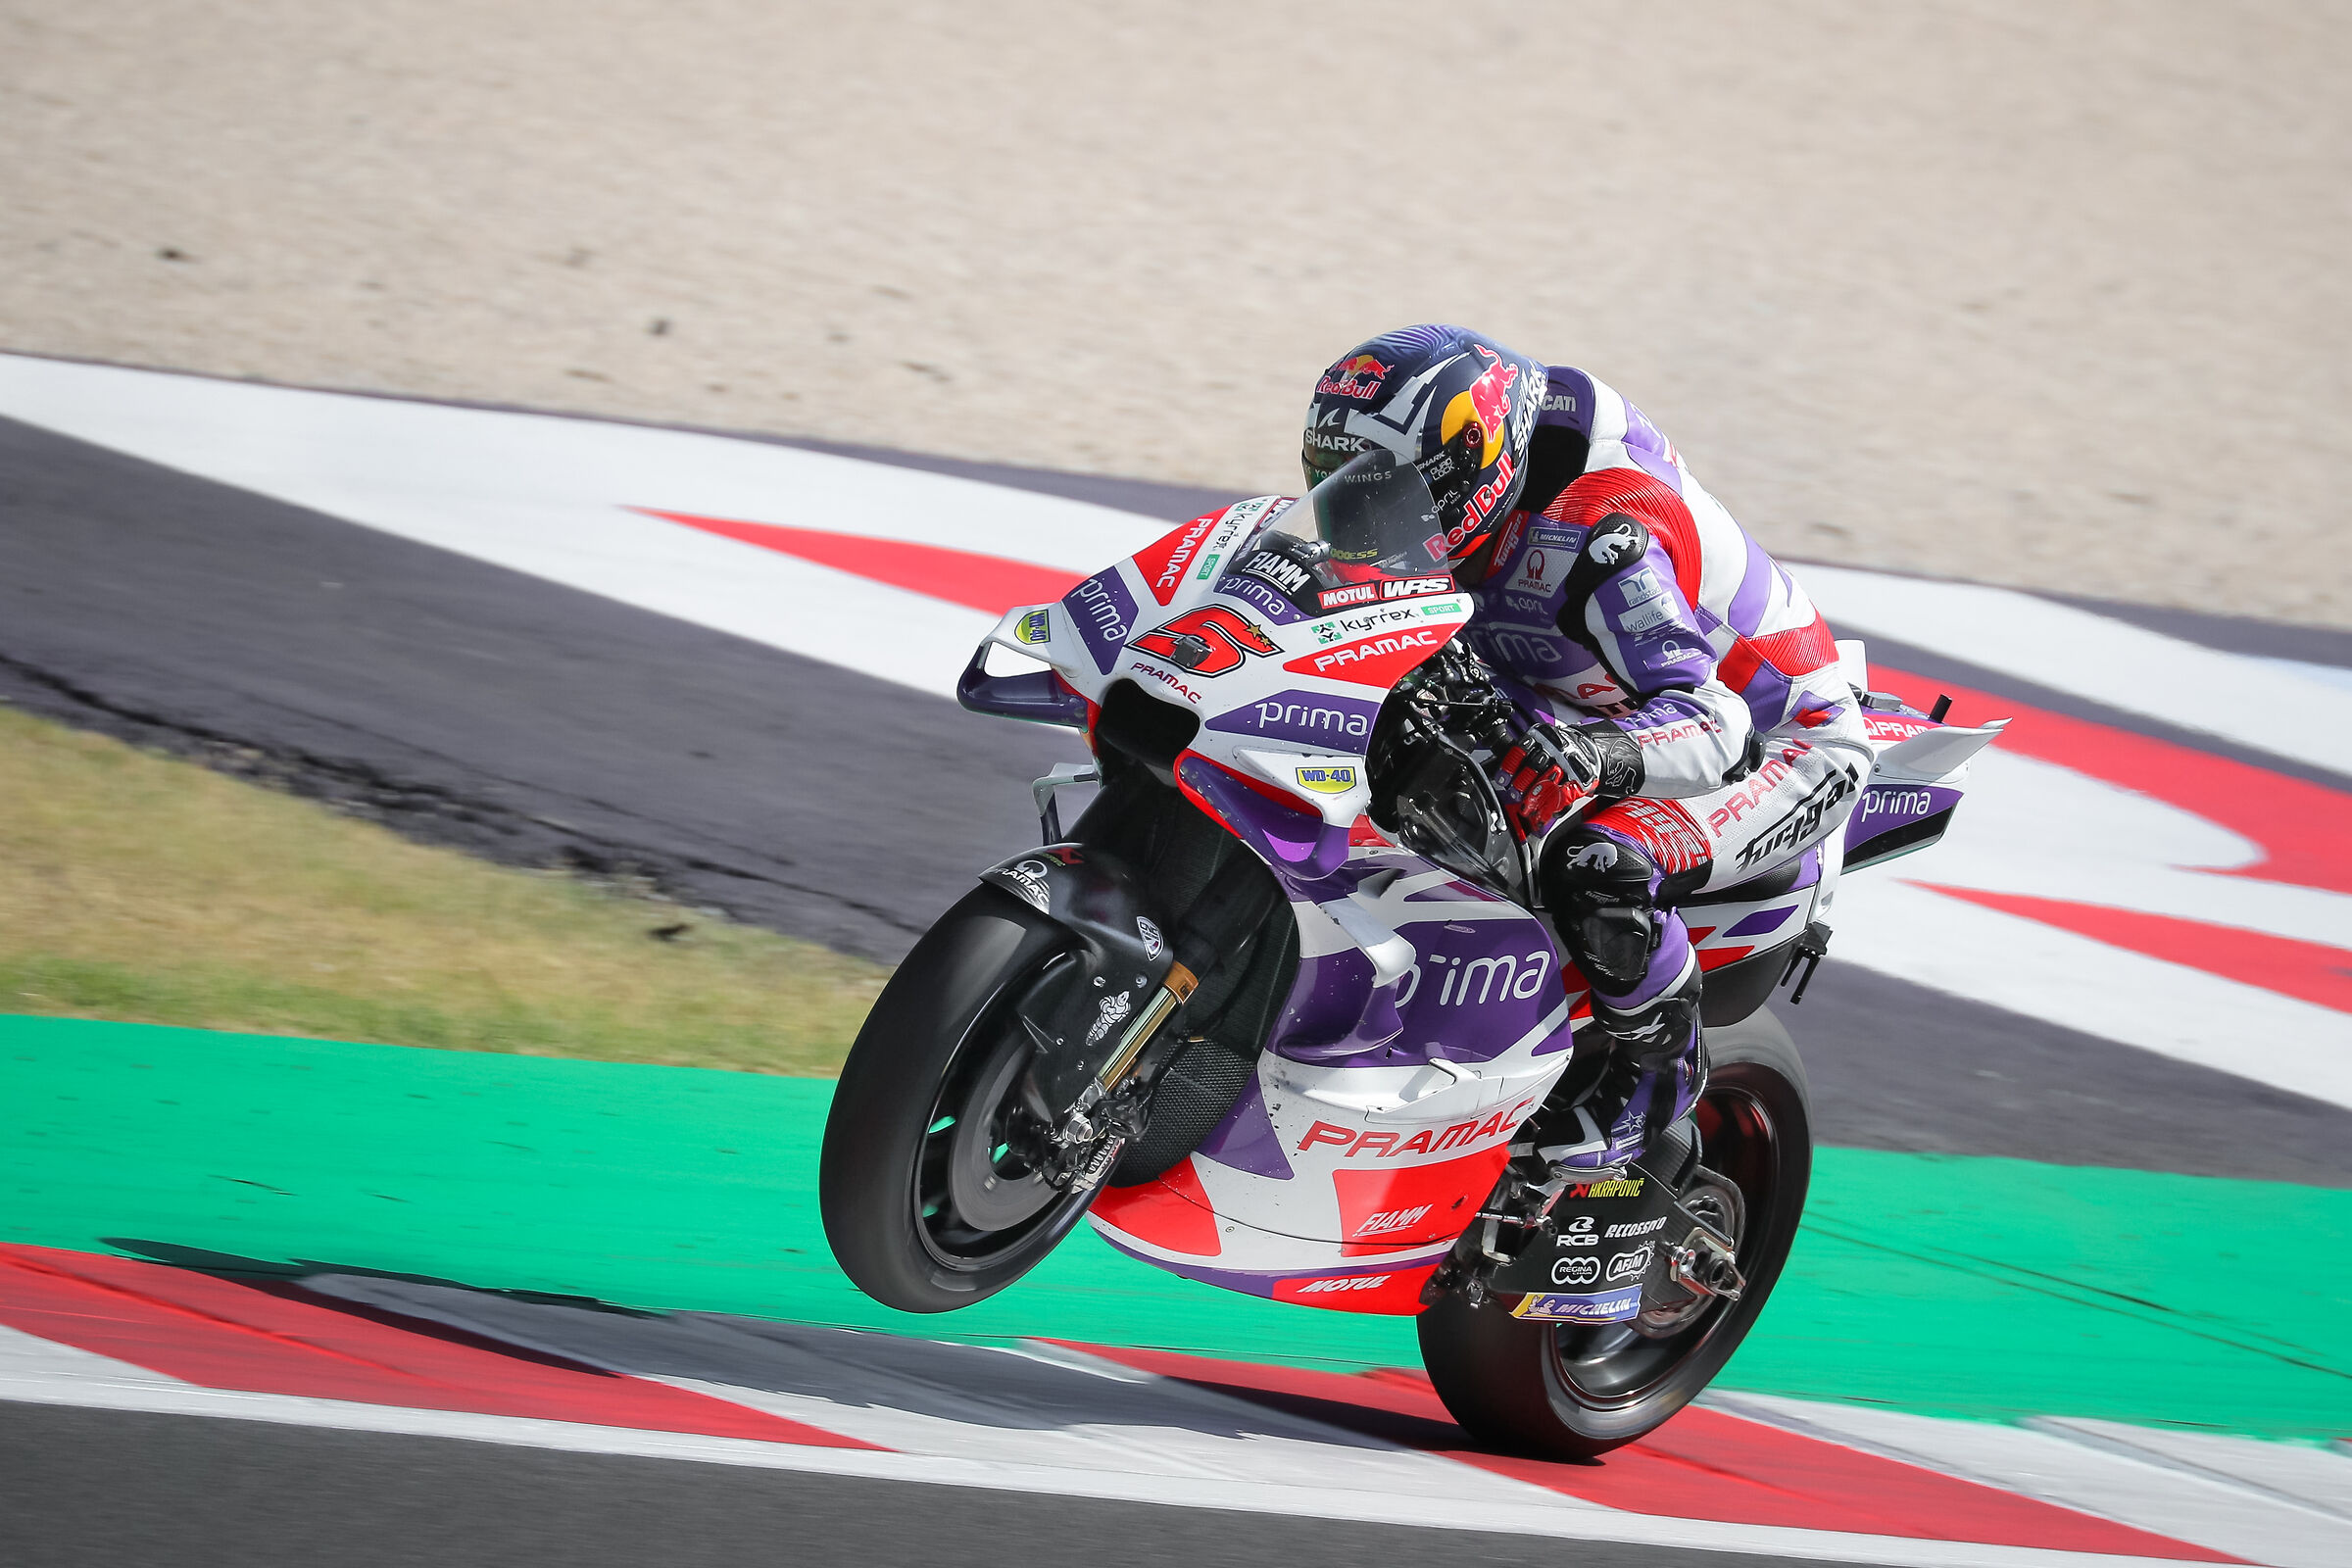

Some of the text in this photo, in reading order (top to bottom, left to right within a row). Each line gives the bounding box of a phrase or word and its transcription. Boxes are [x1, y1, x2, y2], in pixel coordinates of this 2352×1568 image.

[1541, 395, 1577, 412] CATI
[1304, 429, 1366, 452] SHARK
[1416, 451, 1446, 470] SHARK
[1344, 471, 1392, 483] WINGS
[1423, 500, 1483, 563] Red
[1473, 450, 1517, 517] Bull
[1540, 533, 1577, 544] MICHELIN
[1155, 517, 1213, 588] PRAMAC
[1246, 551, 1311, 595] FIAMM
[1222, 577, 1287, 616] prima
[1323, 586, 1375, 607] MOTUL
[1384, 577, 1449, 598] WRS
[1518, 579, 1551, 593] PRAMAC
[1629, 586, 1662, 607] randstad
[1070, 577, 1128, 642] prima
[1339, 609, 1413, 632] kyrrex
[1427, 604, 1455, 615] SPORT
[1627, 611, 1664, 633] wallife
[1124, 603, 1285, 678] 5
[1313, 631, 1438, 672] PRAMAC
[1130, 662, 1202, 705] PRAMAC
[1255, 702, 1368, 736] prima
[1301, 767, 1352, 783] WD-40
[1861, 790, 1932, 823] prima
[1297, 1096, 1536, 1158] PRAMAC
[1356, 1204, 1433, 1233] FIAMM
[1556, 1234, 1599, 1247] RCB
[1297, 1275, 1392, 1294] MOTUL
[1555, 1298, 1632, 1315] MICHELIN
